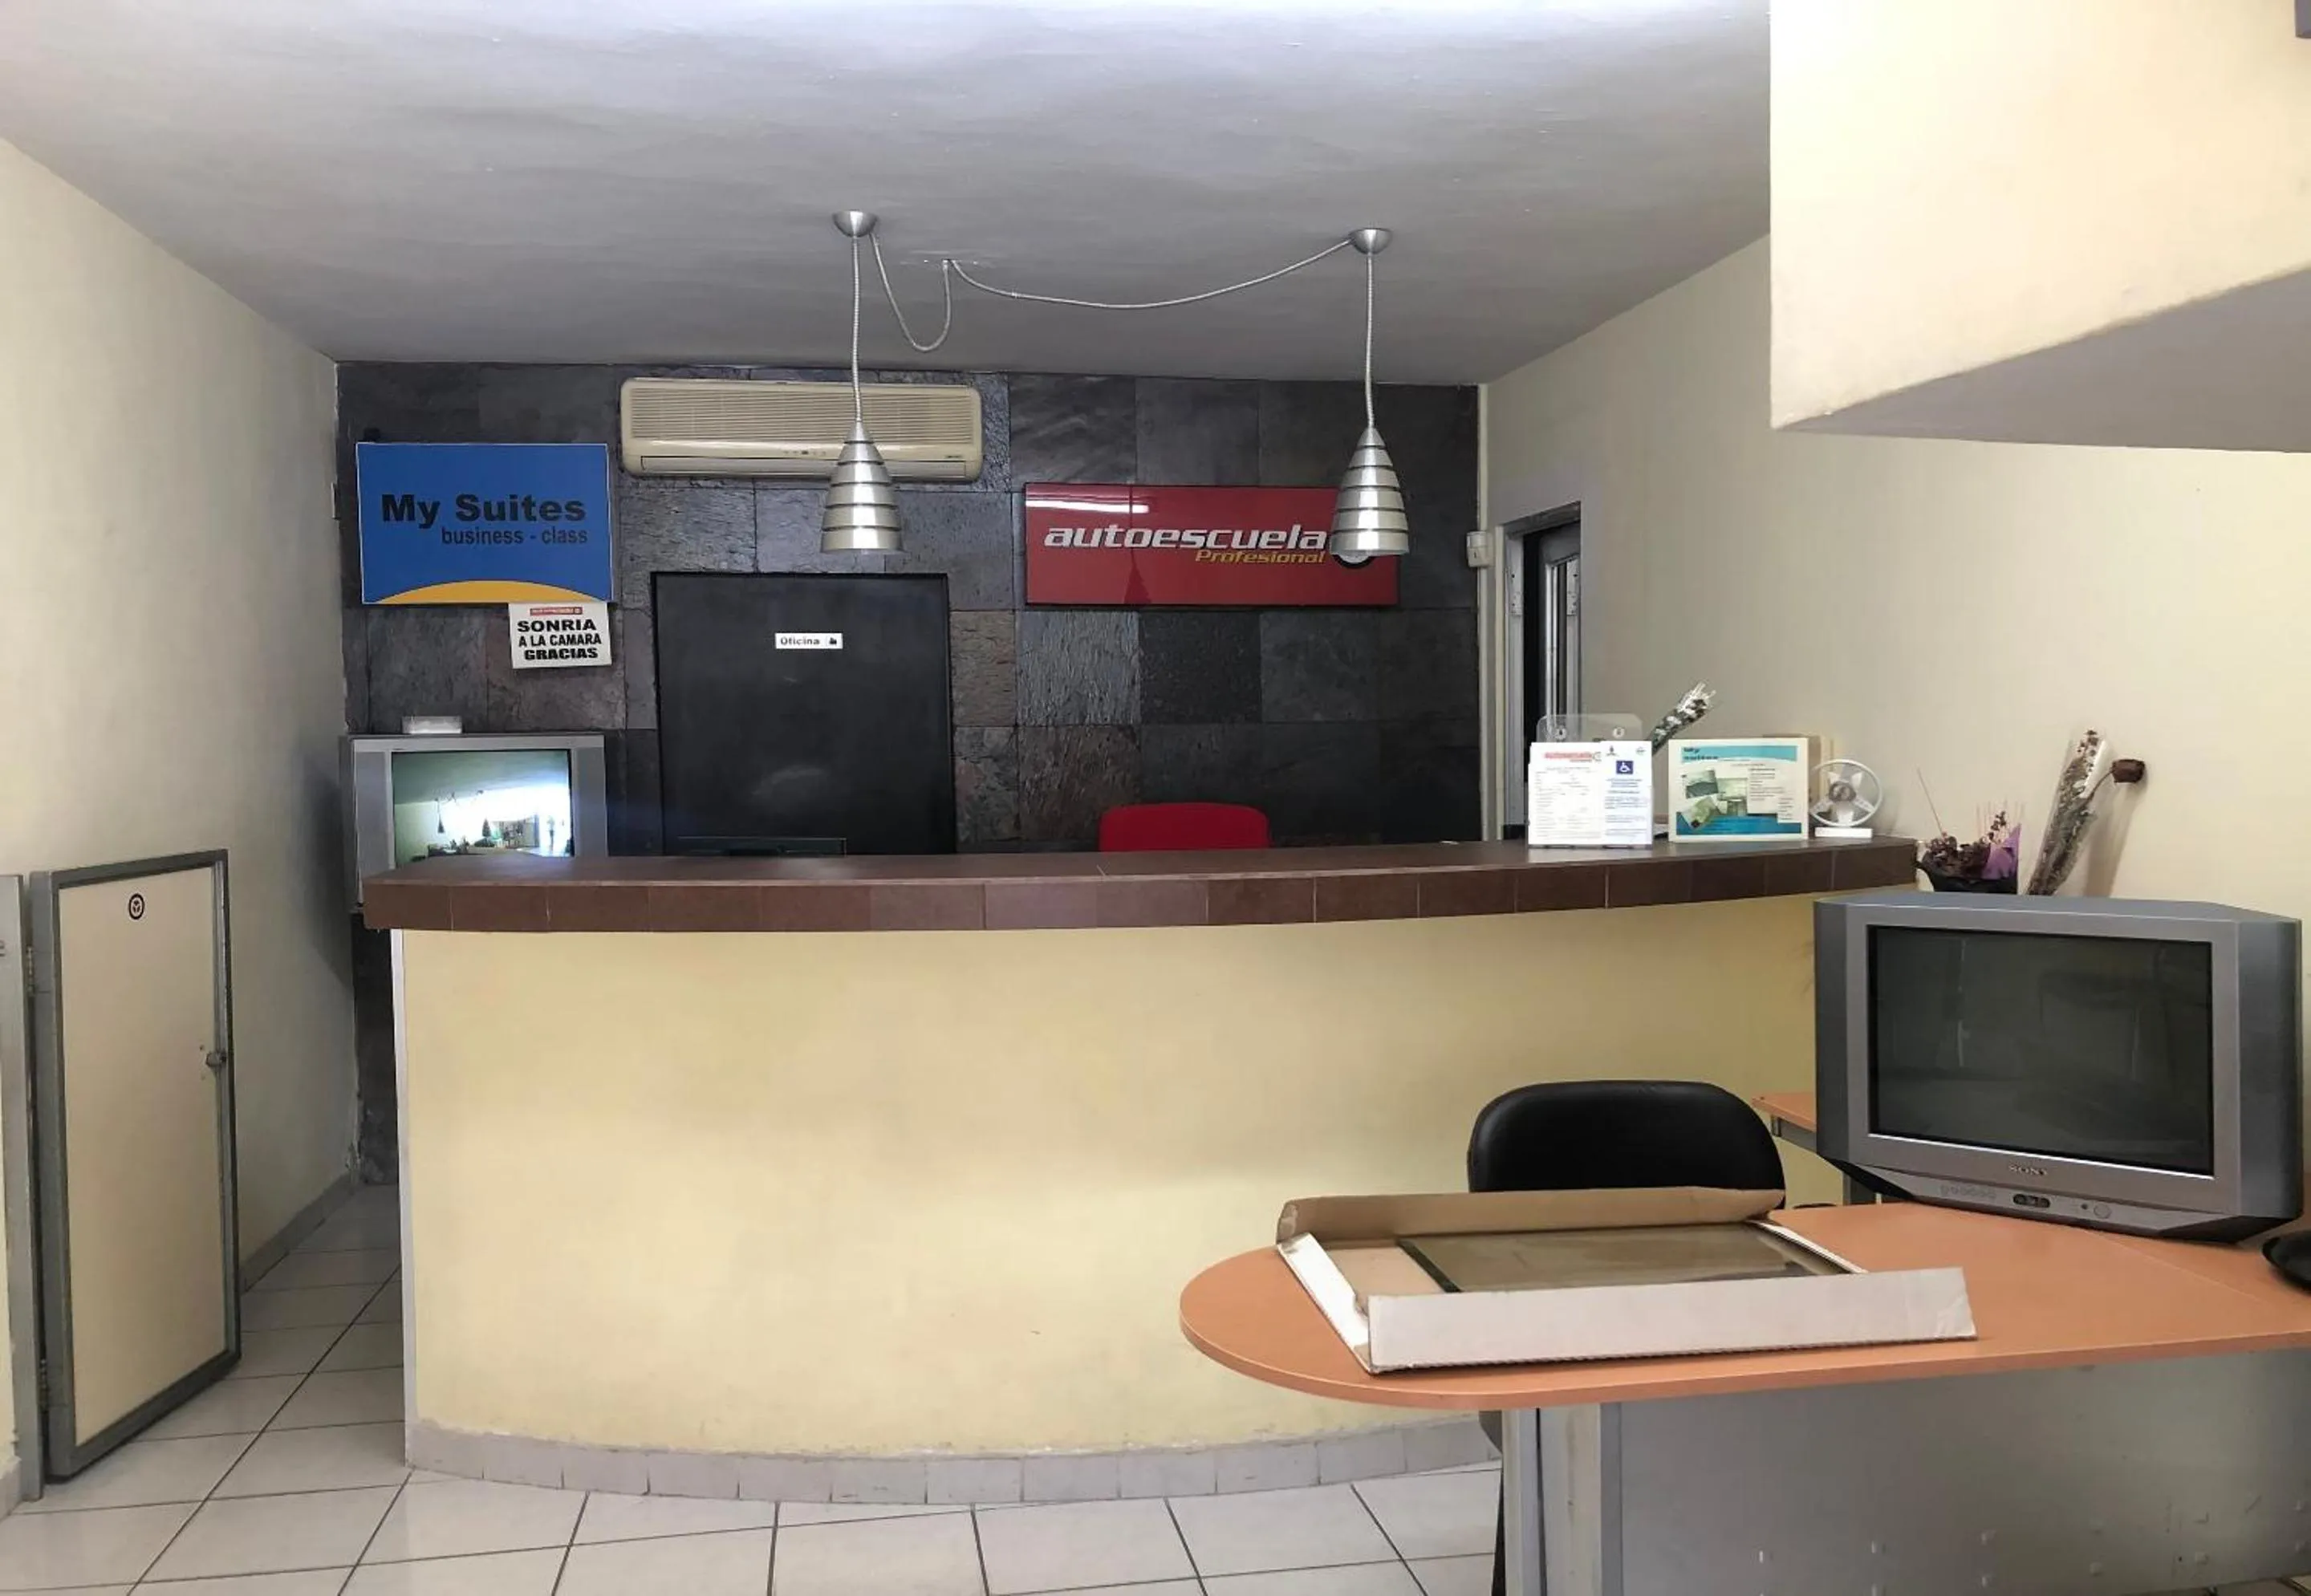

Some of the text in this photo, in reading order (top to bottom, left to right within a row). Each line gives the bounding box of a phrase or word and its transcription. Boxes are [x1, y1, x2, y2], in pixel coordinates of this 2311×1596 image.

[381, 493, 586, 529] My Suites
[441, 526, 524, 545] business
[542, 526, 588, 545] class
[1044, 524, 1327, 550] autoescuela
[1195, 549, 1326, 564] Profesional
[517, 619, 597, 632] SONRIA
[518, 633, 602, 647] A LA CAMARA
[780, 636, 820, 645] Oficina
[524, 648, 599, 660] GRACIAS
